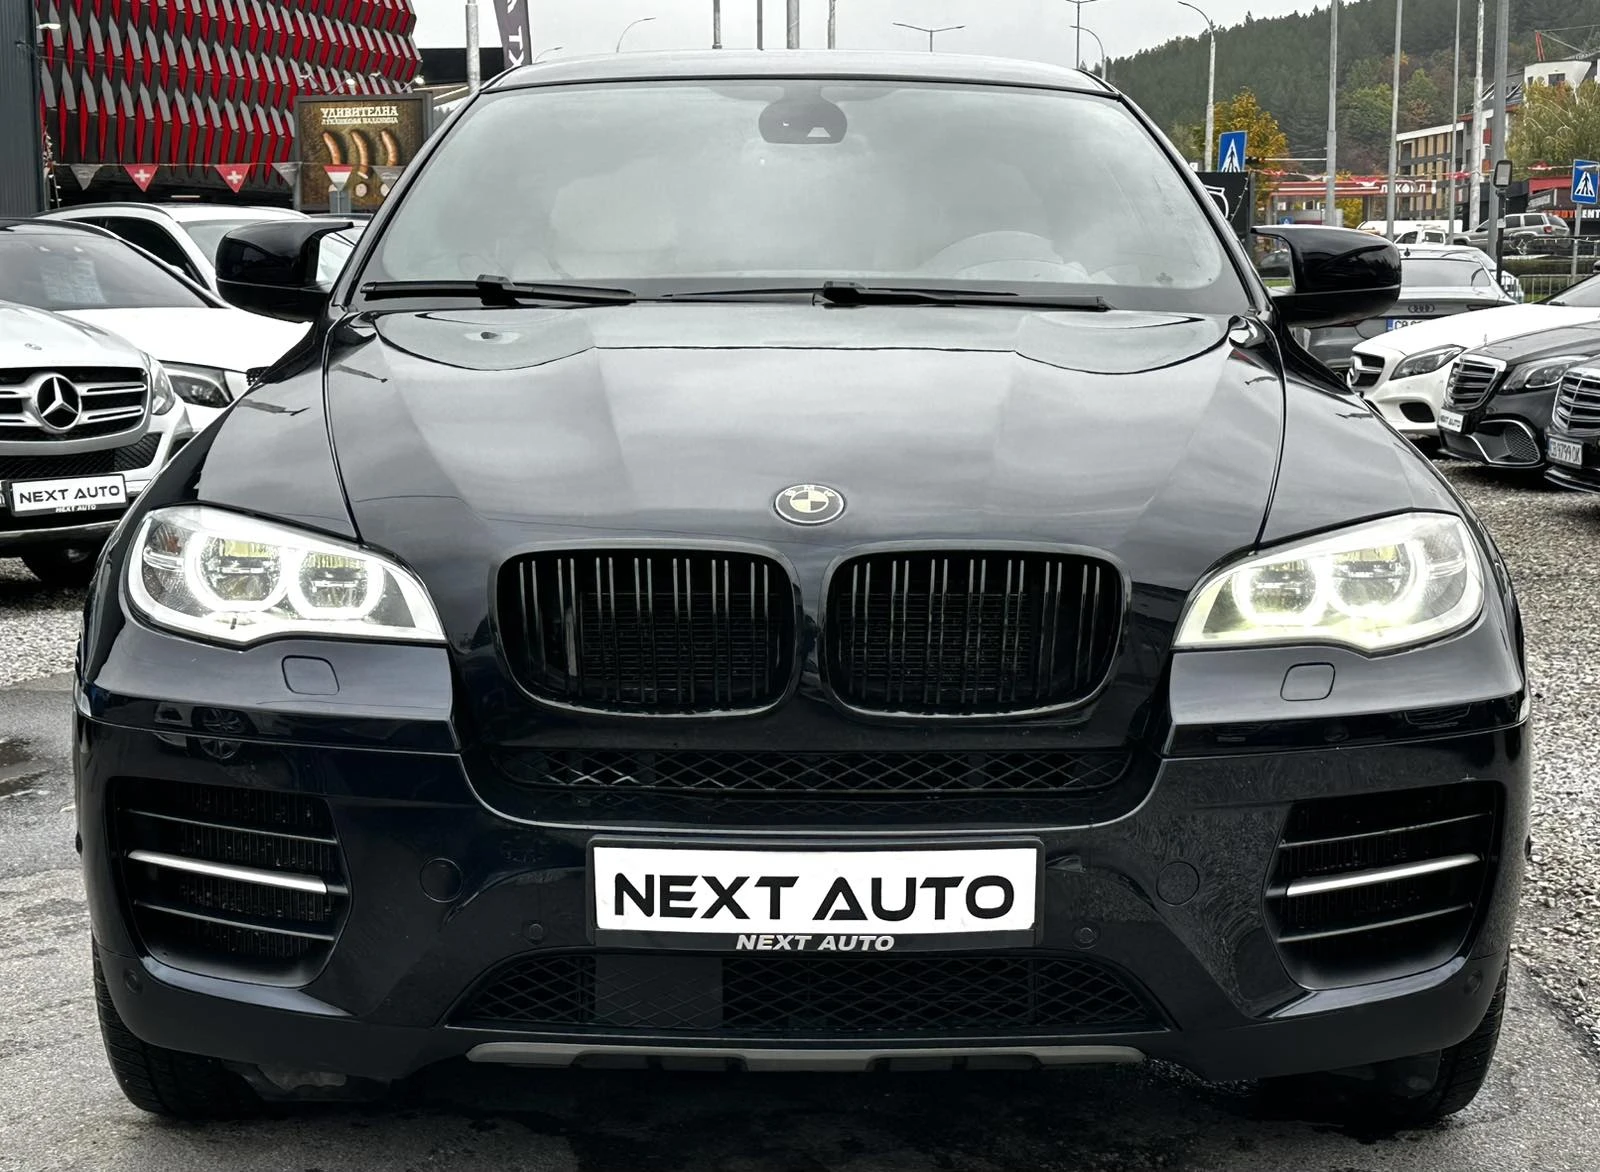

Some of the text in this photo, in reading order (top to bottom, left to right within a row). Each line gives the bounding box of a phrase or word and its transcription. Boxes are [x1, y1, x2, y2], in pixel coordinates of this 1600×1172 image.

[320, 106, 399, 118] УДИВИТЕЛНА
[19, 485, 120, 504] NEXT AUTO
[614, 872, 1015, 922] NEXT AUTO
[735, 934, 896, 951] NEXT AUTO
